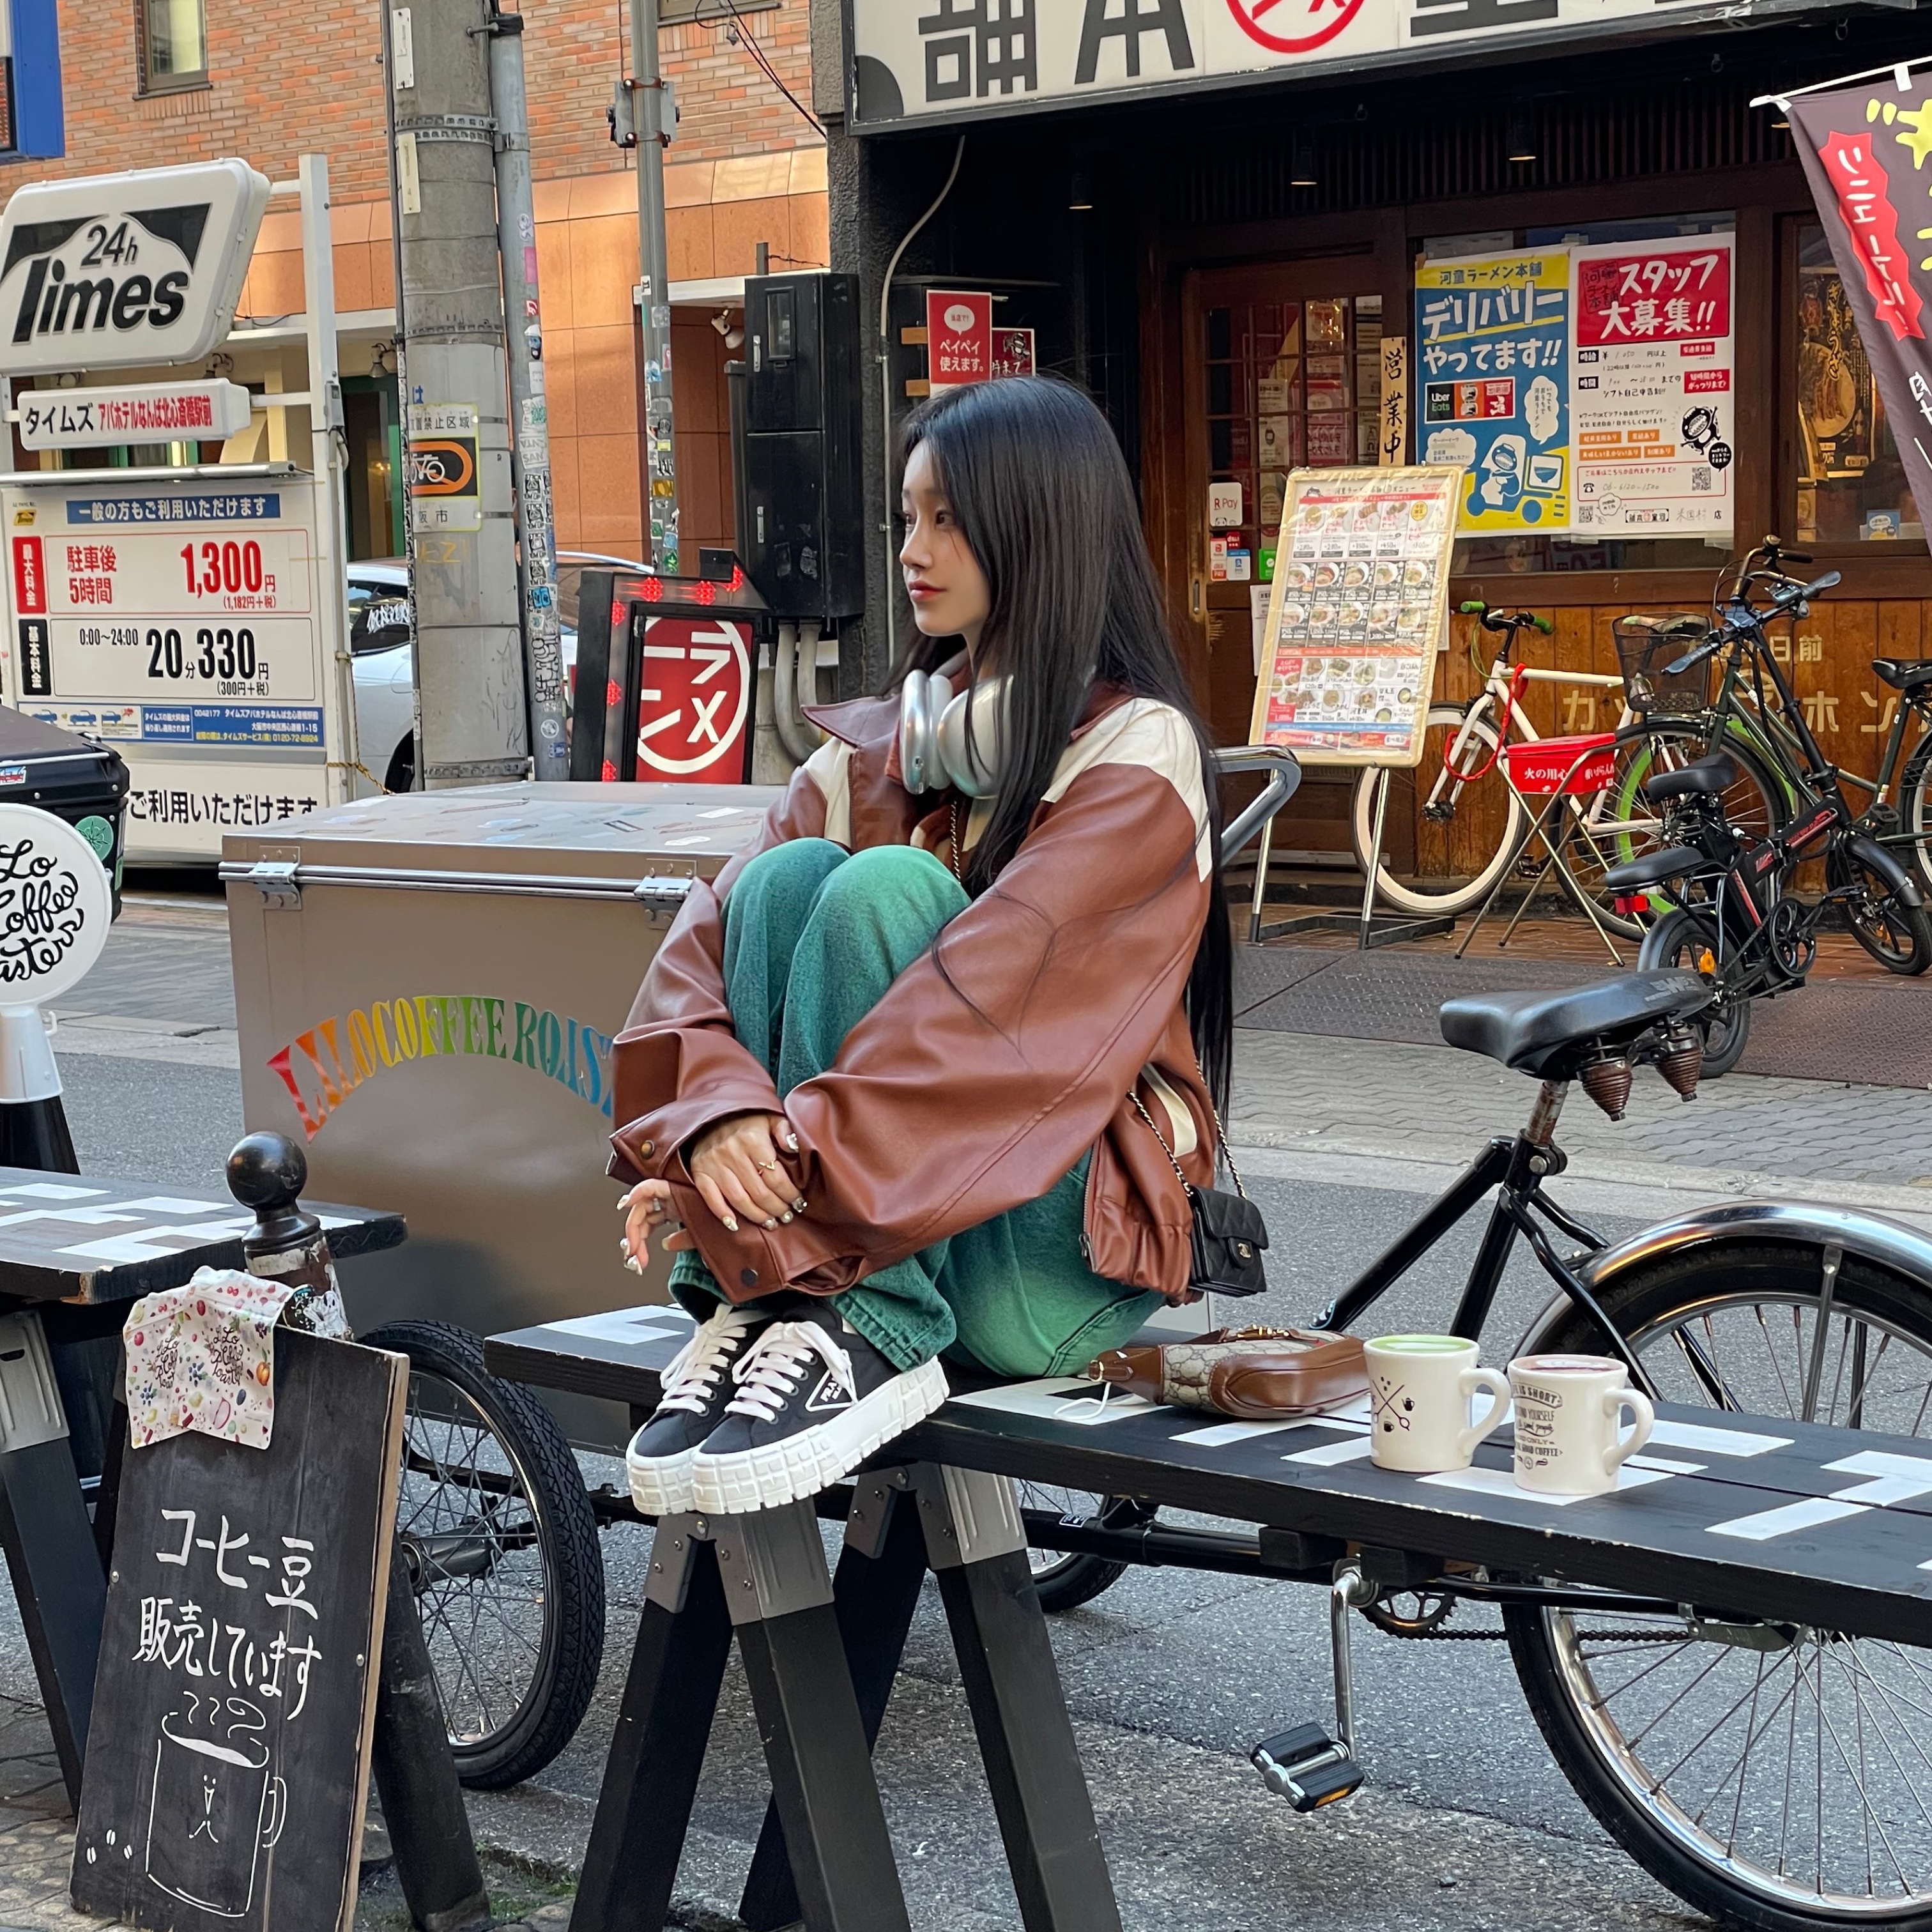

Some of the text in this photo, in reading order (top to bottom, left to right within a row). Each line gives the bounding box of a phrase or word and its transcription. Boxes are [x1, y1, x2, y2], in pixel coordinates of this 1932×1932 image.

[80, 222, 139, 268] 24h
[1439, 261, 1542, 285] 河童ラーメン本舗
[1618, 255, 1719, 296] スタッフ
[1423, 280, 1563, 342] デリバリー
[940, 339, 980, 355] ペイペイ
[1383, 347, 1404, 464] 営業中
[1431, 393, 1450, 402] Uber
[25, 402, 94, 436] タイムズ
[410, 415, 470, 431] 置禁止区域
[79, 497, 266, 521] 一般の方もご利用いただけます
[1222, 498, 1238, 510] Pay
[419, 510, 447, 524] 阪市
[66, 545, 117, 573] 駐車後
[68, 577, 112, 604] 5時間
[0, 839, 57, 884] Lo
[820, 1377, 838, 1402] PRA
[1528, 1386, 1558, 1404] SHORT
[1528, 1408, 1554, 1422] YOURSELF
[1535, 1447, 1558, 1457] COFFEE
[157, 1508, 318, 1620] コーヒー豆
[132, 1597, 322, 1721] 販売しています
